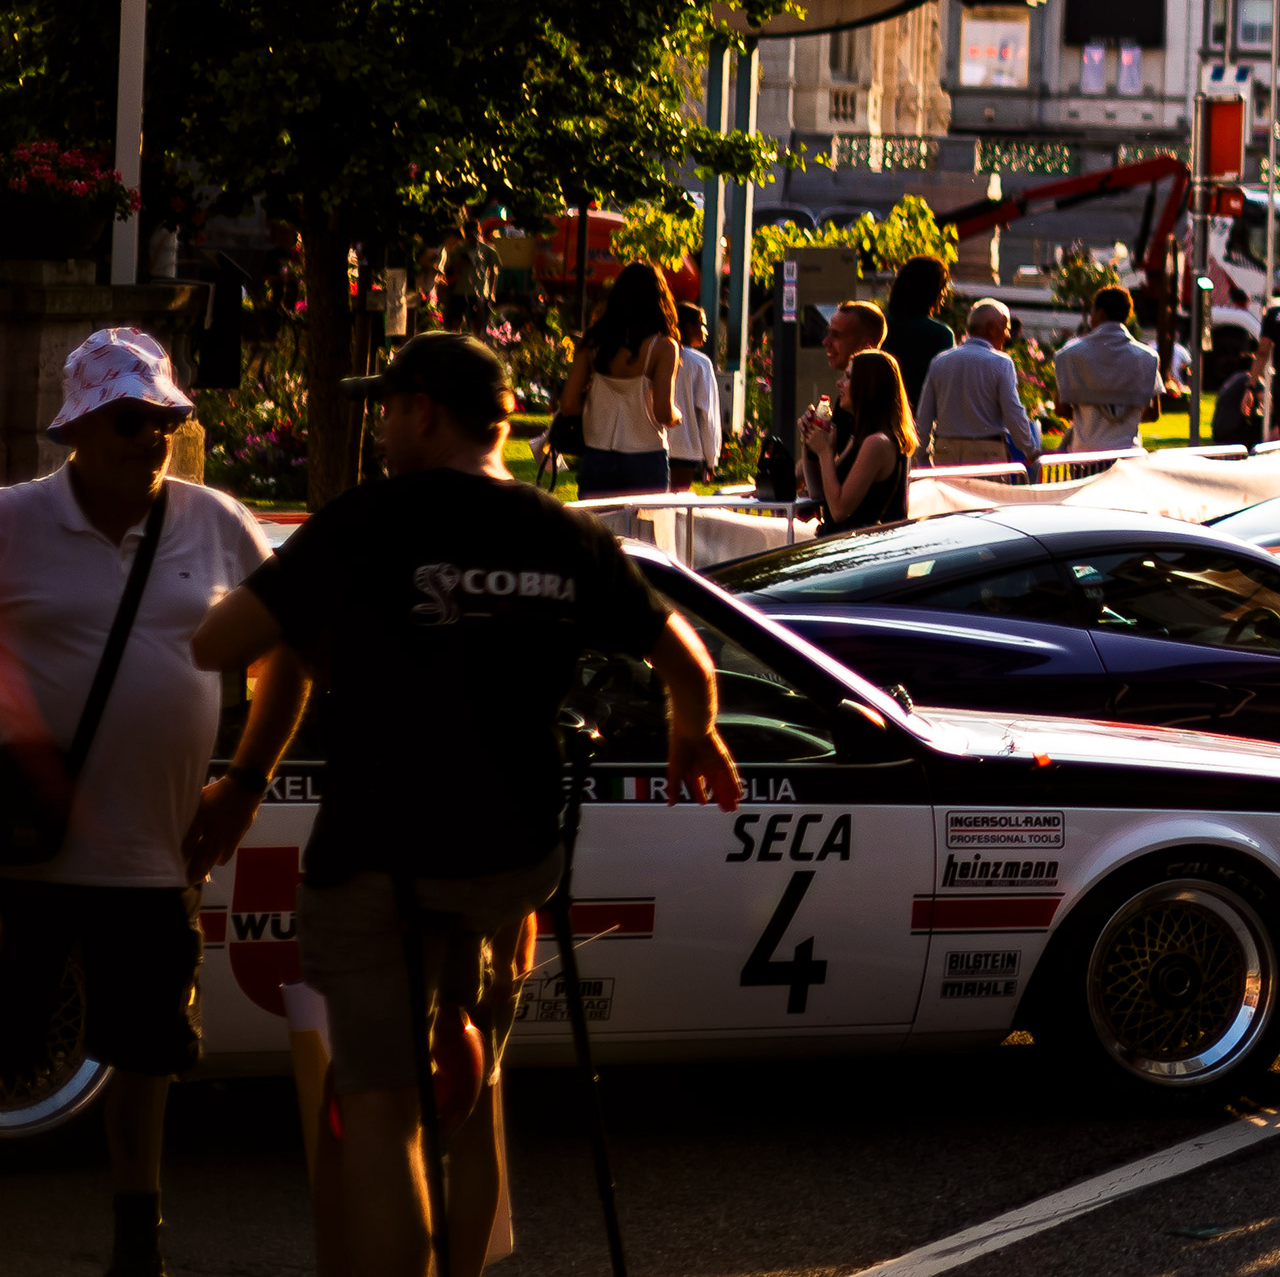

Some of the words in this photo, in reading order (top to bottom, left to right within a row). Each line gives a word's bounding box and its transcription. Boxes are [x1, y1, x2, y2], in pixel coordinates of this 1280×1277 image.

[460, 568, 577, 603] COBRA
[950, 816, 1061, 828] INGERSOLL-RAND
[725, 813, 852, 863] SECA
[950, 834, 1027, 844] PROFESSIONAL
[1028, 834, 1061, 844] TOOLS
[942, 853, 1059, 887] heinzmann
[739, 870, 828, 1014] 4
[948, 952, 1018, 970] BILSTEIN
[554, 981, 604, 997] PMA
[942, 982, 1016, 997] MAHLE
[541, 1001, 608, 1011] GEAG
